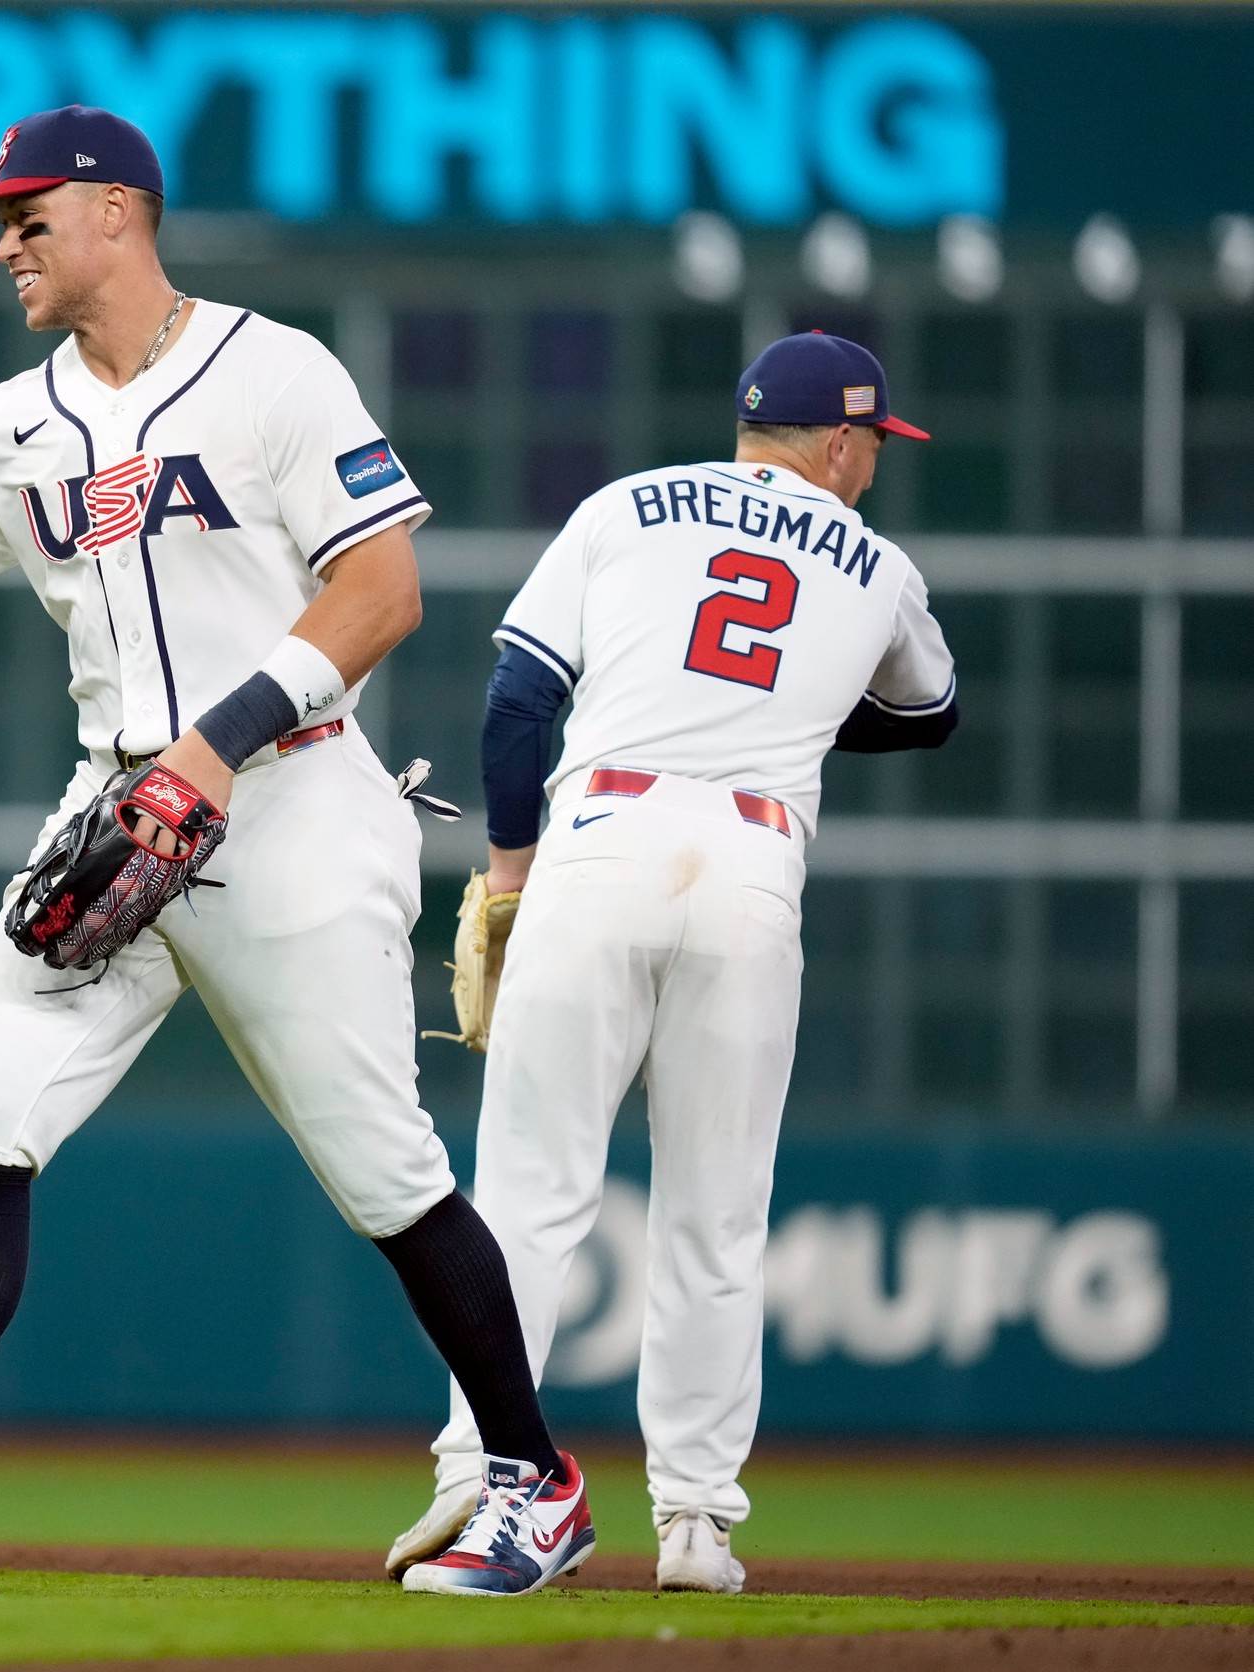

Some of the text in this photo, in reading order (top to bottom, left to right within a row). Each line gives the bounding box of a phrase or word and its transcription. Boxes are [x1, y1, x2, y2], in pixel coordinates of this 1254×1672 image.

[18, 452, 242, 563] USA
[632, 480, 881, 588] BREGMAN
[684, 547, 800, 692] 2
[489, 1471, 517, 1485] USA
